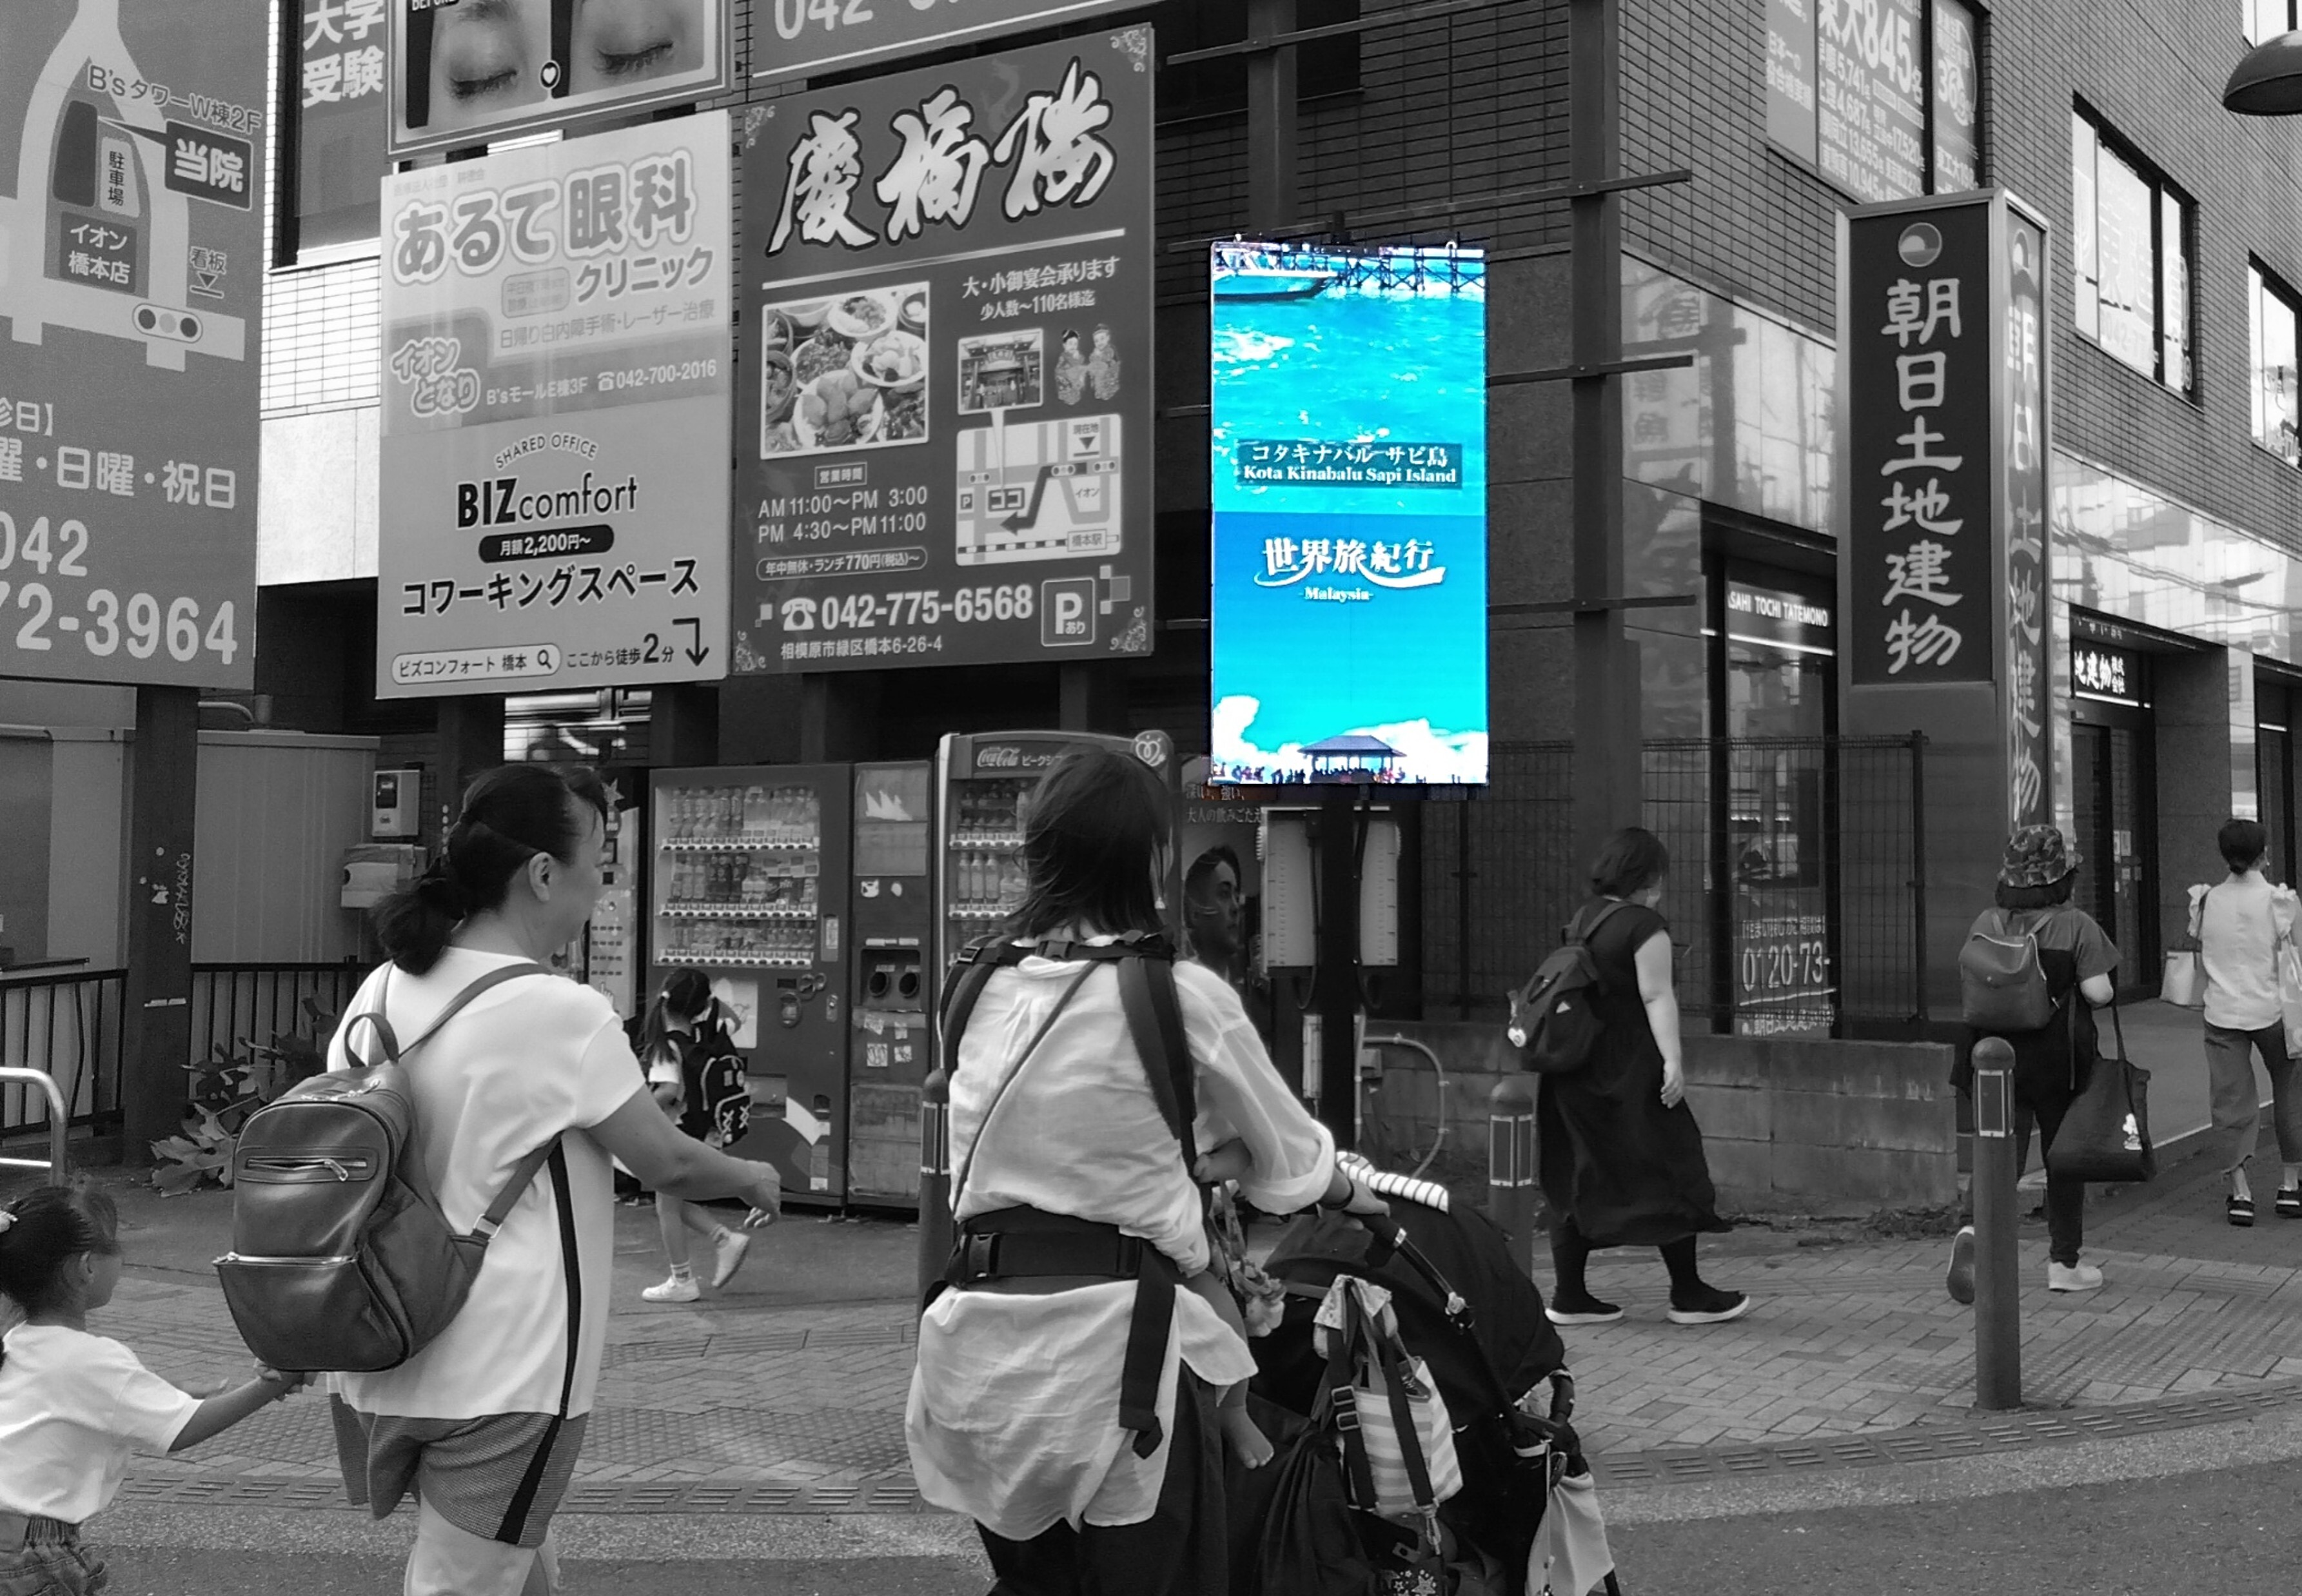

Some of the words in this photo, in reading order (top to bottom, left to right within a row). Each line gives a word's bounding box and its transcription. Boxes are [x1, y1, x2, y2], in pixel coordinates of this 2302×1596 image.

[303, 0, 385, 50] 大学
[302, 45, 385, 108] 受験
[89, 65, 261, 133] B'sタワーW棟2F
[108, 151, 125, 206] 駐車場
[174, 138, 244, 193] 当院
[395, 152, 694, 282] あるて眼科
[70, 224, 128, 251] イオン
[68, 251, 131, 285] 橋本店
[191, 248, 226, 272] 看板
[576, 246, 713, 303] クリニック
[962, 255, 1120, 299] 大・小御宴会承ります
[393, 339, 459, 382] イオン
[616, 359, 717, 389] 042-700-2016
[413, 370, 479, 416] となり
[1072, 423, 1099, 435] 現在地
[495, 435, 546, 470] SHARED
[551, 433, 598, 460] OFFICE
[1075, 487, 1100, 499] イオン
[1244, 466, 1283, 480] Kota
[1287, 466, 1363, 482] Kinabalu
[1366, 468, 1401, 484] Sapi
[1406, 469, 1456, 482] Island
[1881, 277, 1963, 675] 朝日土地建物
[457, 472, 638, 529] BIZcomfort
[758, 498, 785, 518] AM
[889, 486, 927, 507] 3:00
[990, 490, 1023, 509] ココ
[758, 523, 784, 544] PM
[880, 511, 927, 534] 11:00
[1071, 533, 1103, 547] 橋本駅
[1261, 537, 1435, 578] 世界旅紀行
[402, 558, 700, 616] コワーキングスペース
[821, 585, 1034, 631] 042-775-6568
[1727, 591, 1752, 612] SAHI
[1755, 595, 1782, 618] TOCHI
[1782, 602, 1829, 627] TATEMONO
[398, 658, 495, 678] ビズコンフォート
[502, 653, 528, 673] 橋本
[567, 633, 674, 669] ここから徒歩2分
[781, 635, 943, 660] 相模原市緑区橋本6-26-4
